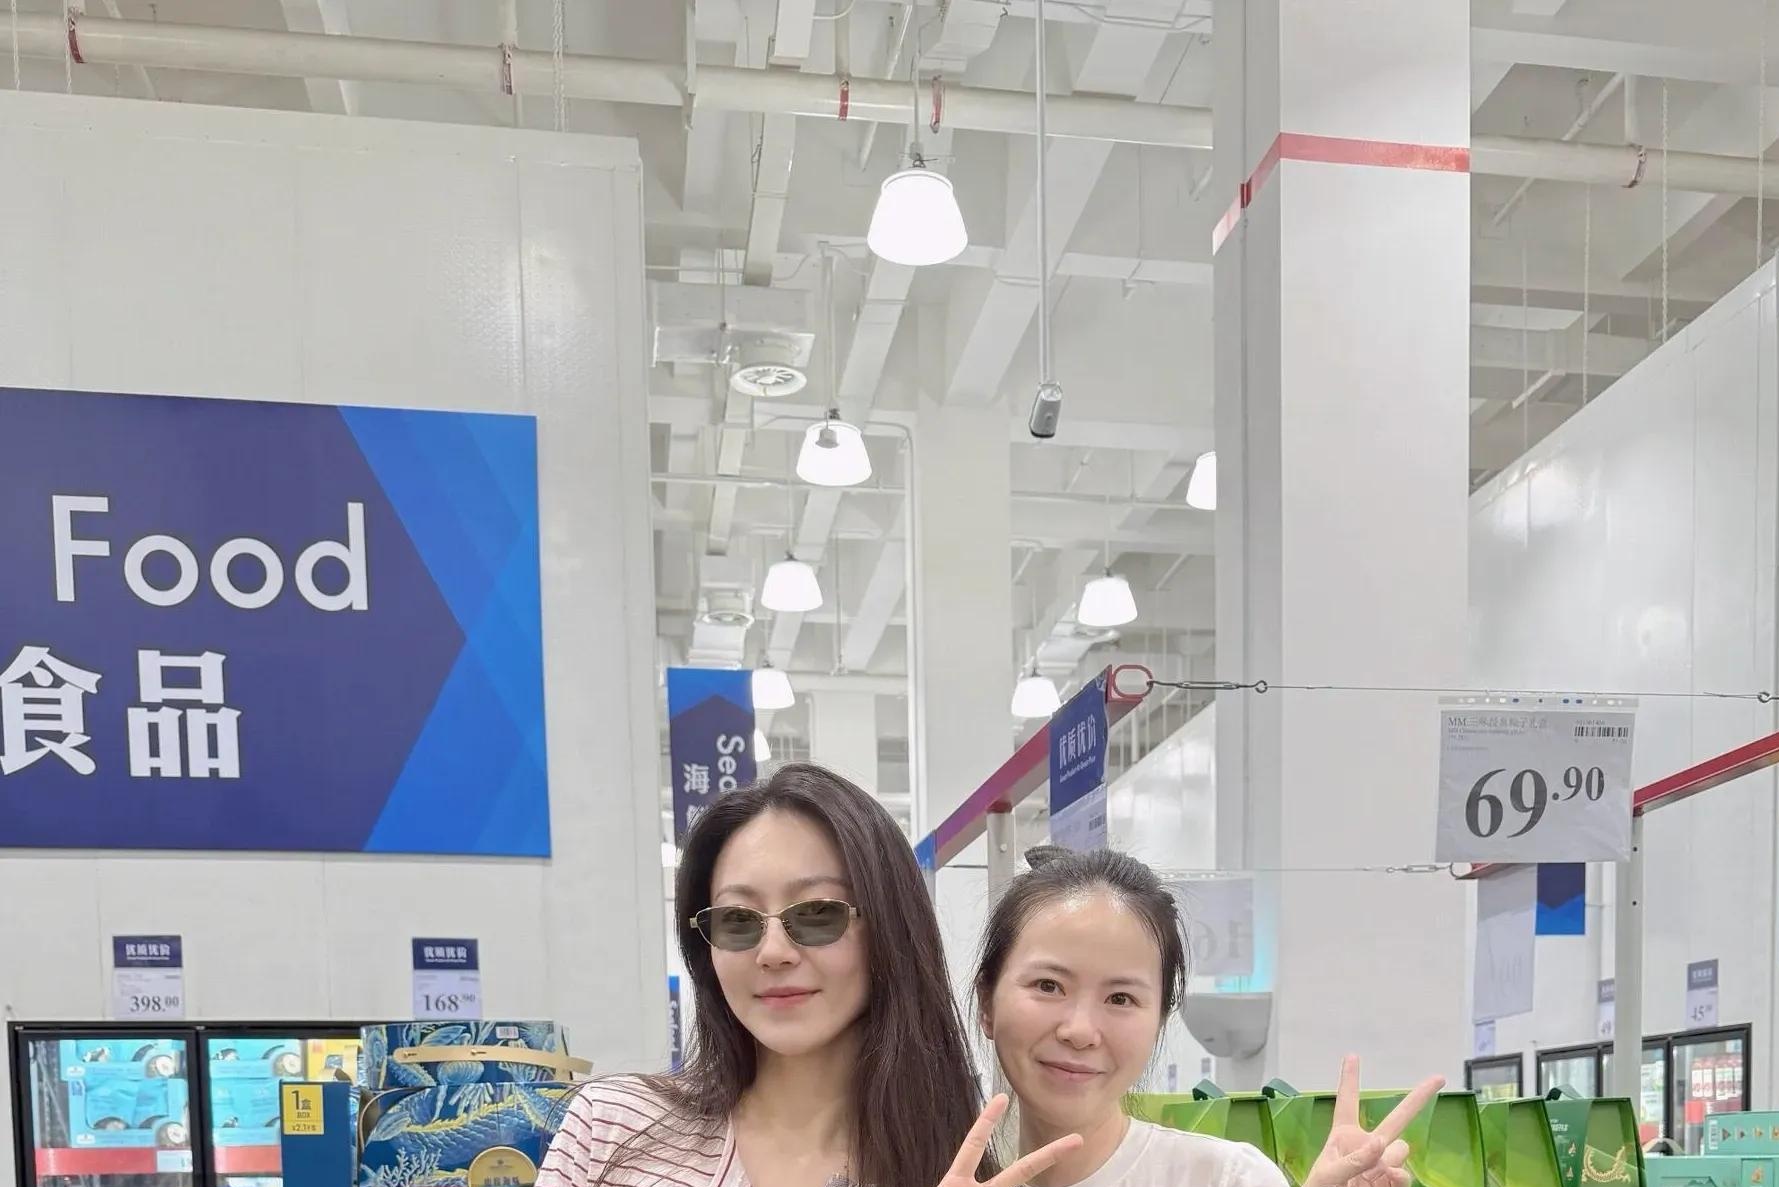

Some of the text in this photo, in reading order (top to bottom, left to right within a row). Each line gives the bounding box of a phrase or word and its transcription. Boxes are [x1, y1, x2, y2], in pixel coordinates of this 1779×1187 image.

[52, 494, 368, 612] Food
[0, 646, 242, 779] 食品
[1465, 766, 1605, 839] 69.90
